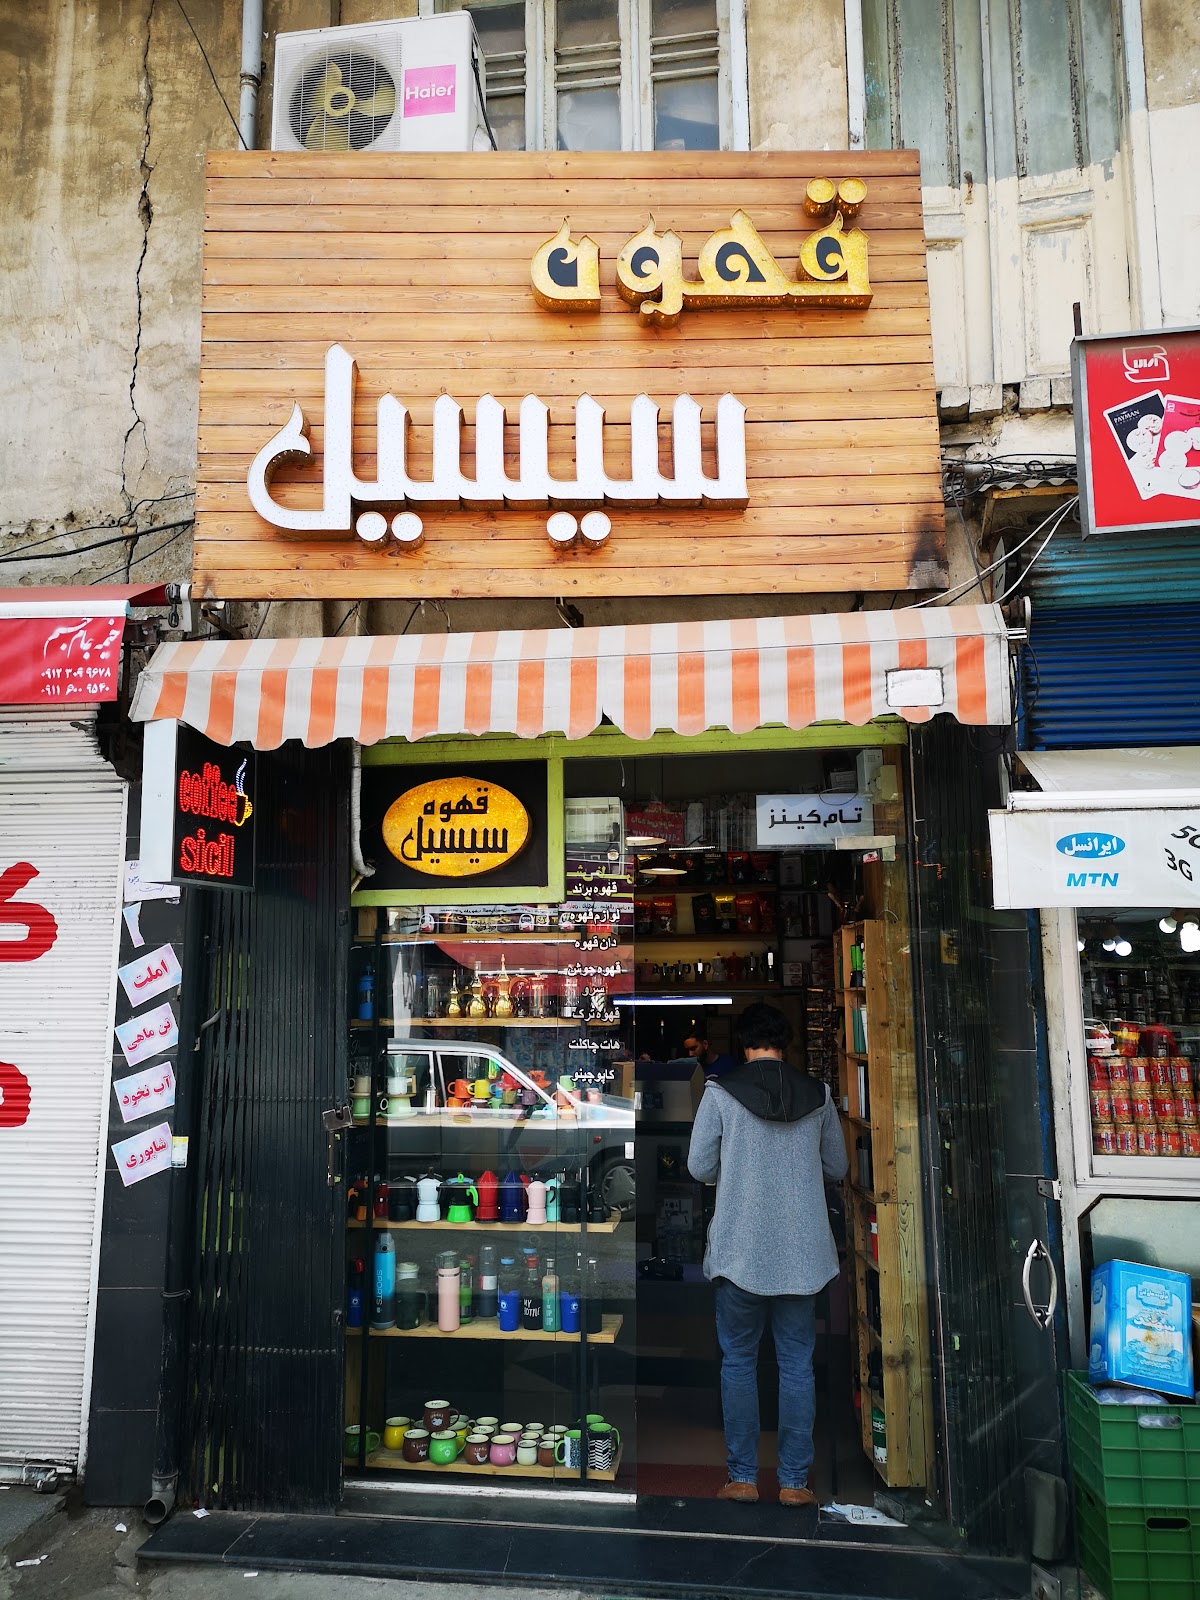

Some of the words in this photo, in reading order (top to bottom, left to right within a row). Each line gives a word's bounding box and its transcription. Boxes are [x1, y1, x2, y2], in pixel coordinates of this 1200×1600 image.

[405, 83, 454, 101] Haier
[531, 177, 873, 328] قهوه
[1113, 409, 1140, 424] PAYMAN
[247, 342, 751, 551] سیسیل
[423, 787, 489, 822] قهوه
[401, 815, 509, 864] سیسیل
[1064, 836, 1118, 856] ایرانسل
[1164, 848, 1193, 881] 3G
[593, 881, 618, 897] قهوه
[1066, 873, 1119, 887] MTN
[570, 908, 594, 924] قهوه
[574, 936, 599, 951] قهوه
[599, 937, 617, 950] دان
[132, 959, 168, 990] املت
[597, 961, 621, 977] قهوه
[596, 1006, 620, 1022] قهوه
[158, 1017, 171, 1037] تن
[127, 1027, 155, 1051] ماهی
[599, 1039, 620, 1050] هات
[153, 1074, 171, 1096] آب
[122, 1084, 151, 1107] نخود
[126, 1138, 167, 1169] شاپوری
[376, 1269, 384, 1306] SPORTS
